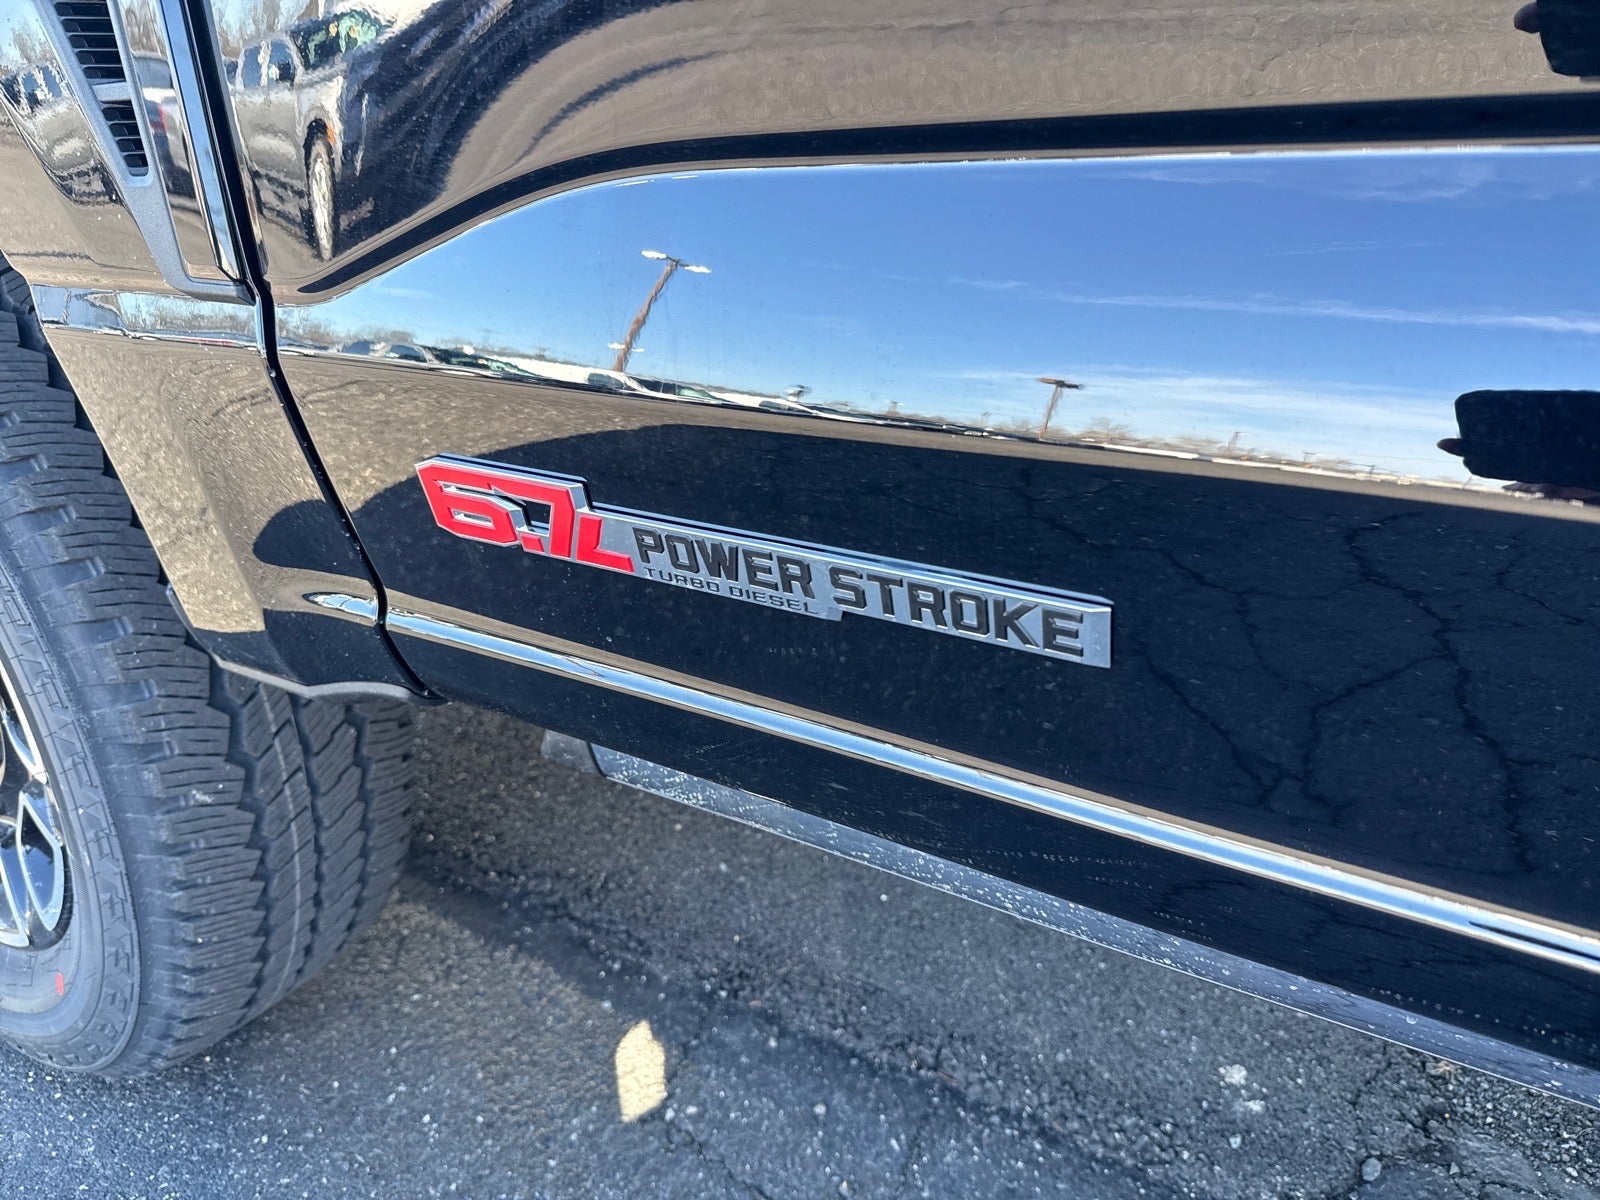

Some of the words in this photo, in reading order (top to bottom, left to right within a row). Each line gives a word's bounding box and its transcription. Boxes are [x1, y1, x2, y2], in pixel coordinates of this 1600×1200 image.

[633, 526, 816, 599] POWER
[828, 565, 1085, 658] STROKE
[643, 566, 720, 594] TURBO
[729, 585, 819, 615] DIESEL
